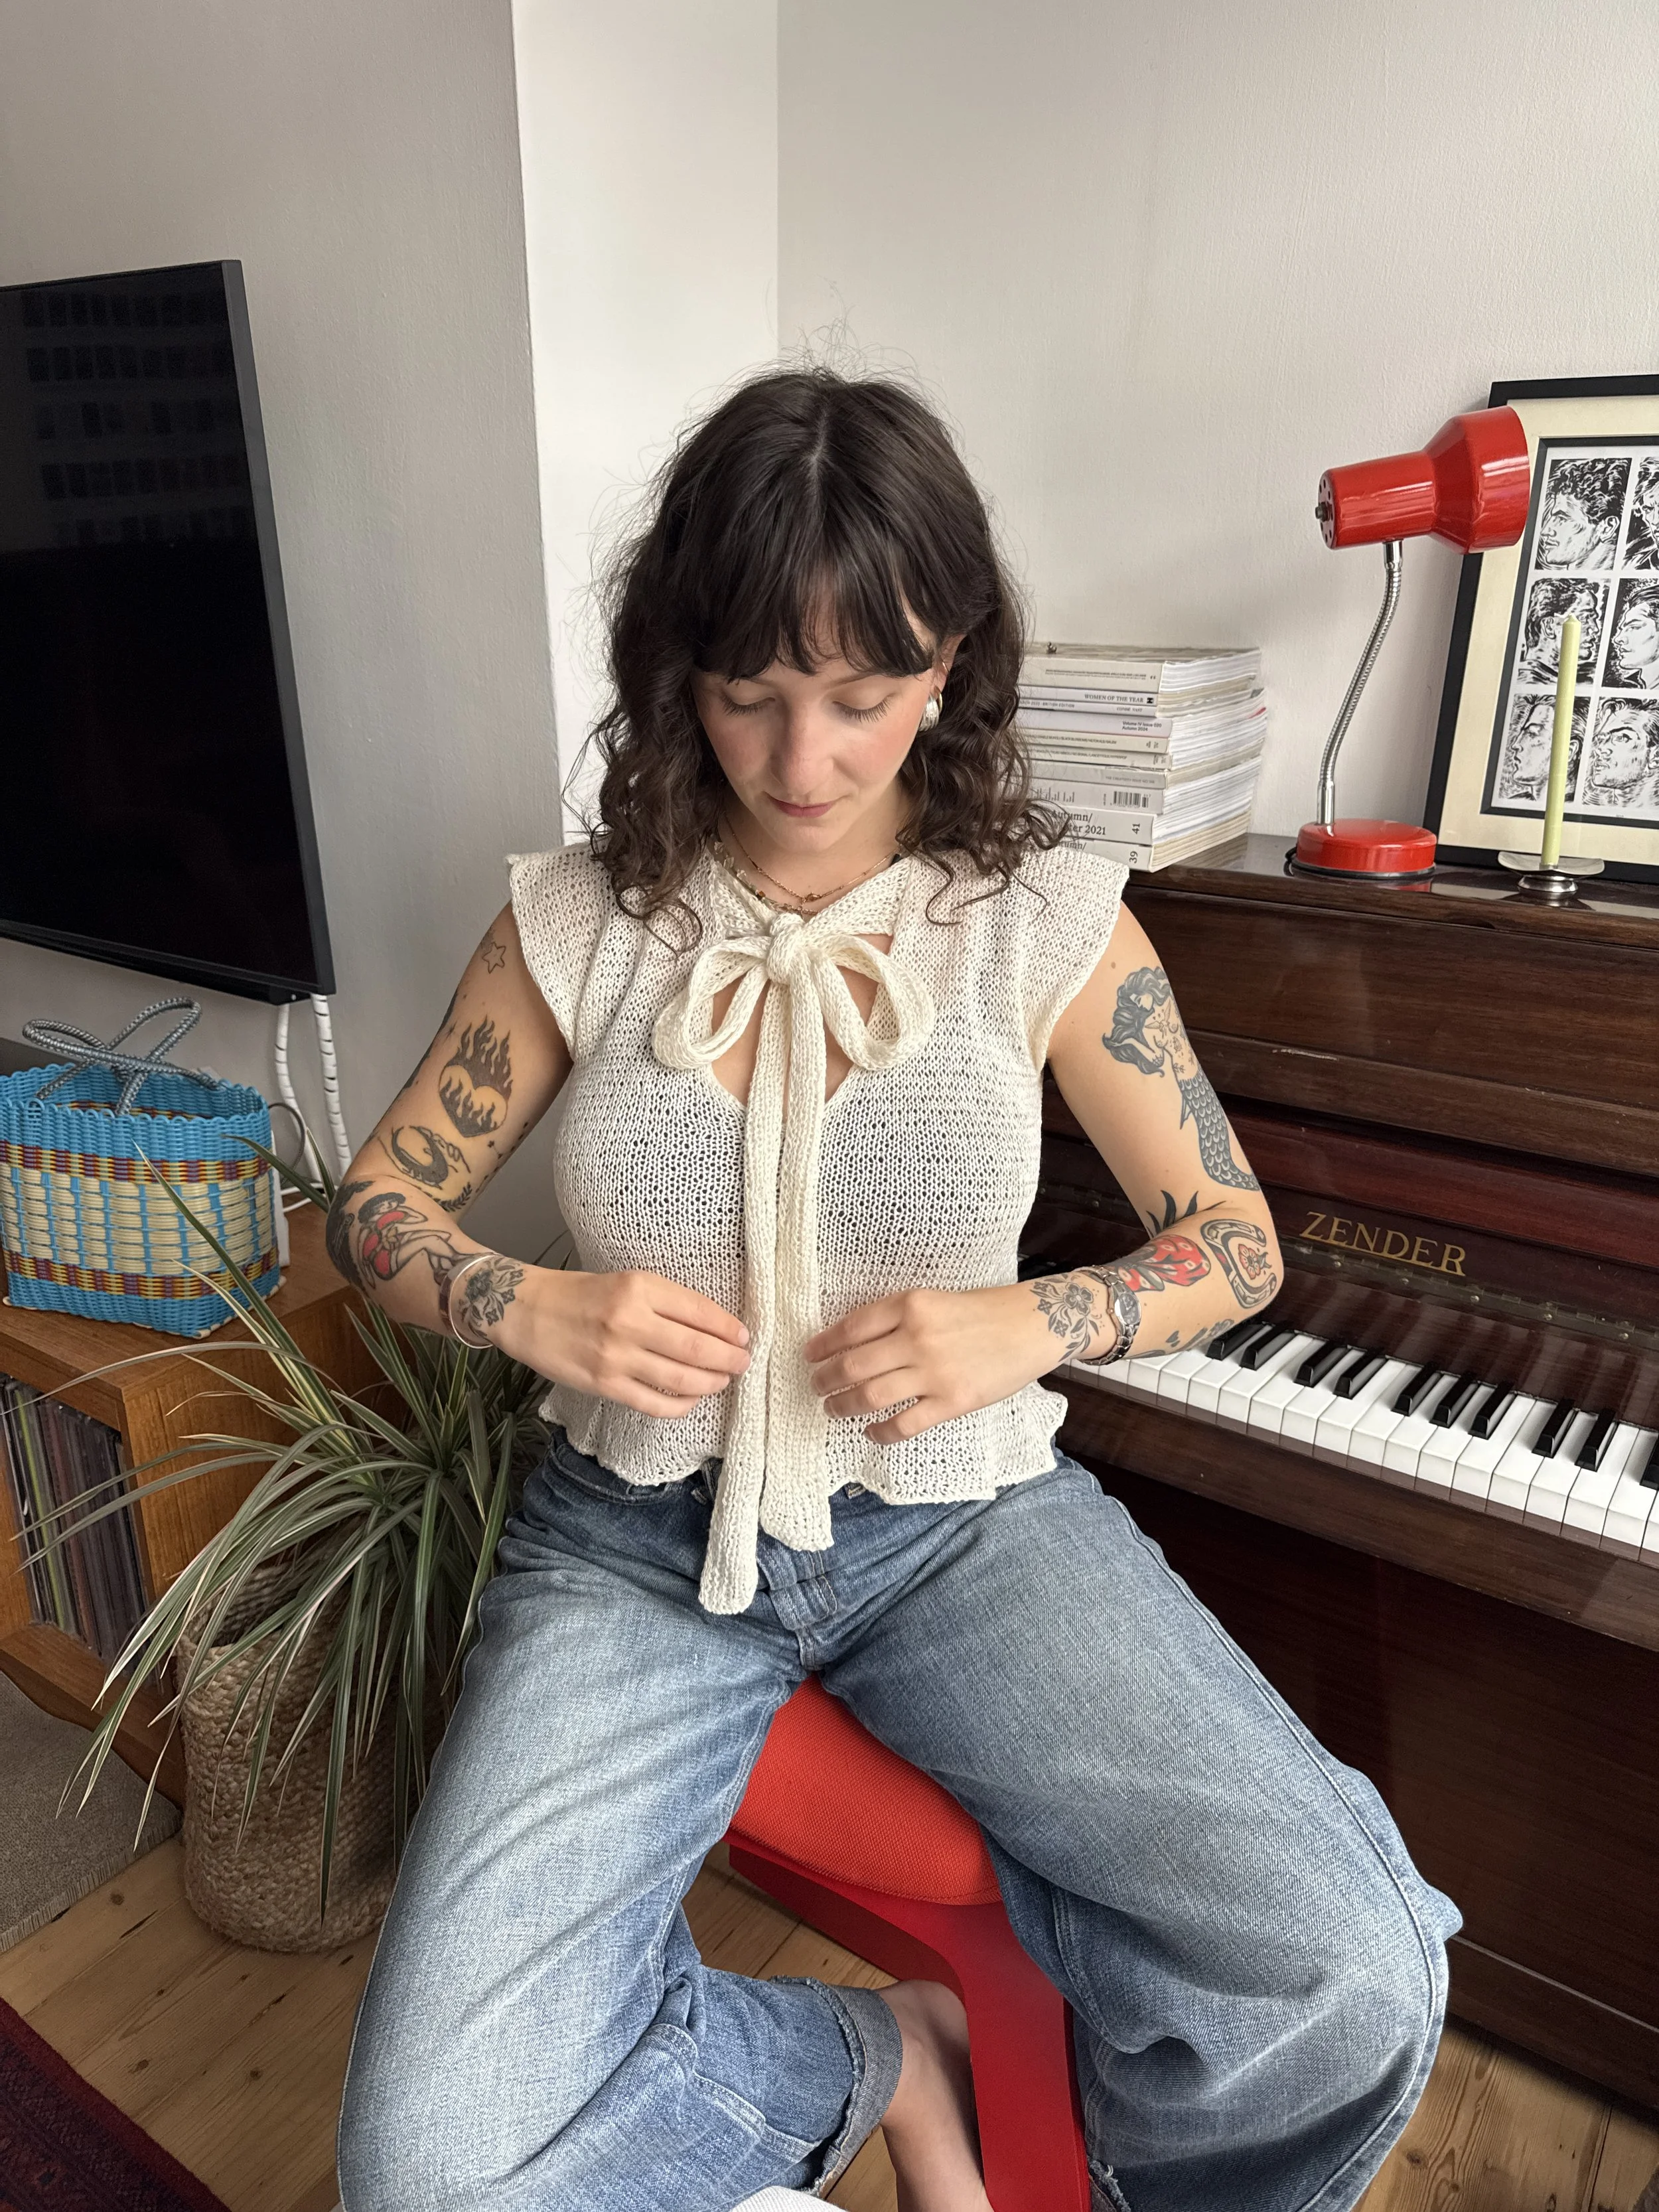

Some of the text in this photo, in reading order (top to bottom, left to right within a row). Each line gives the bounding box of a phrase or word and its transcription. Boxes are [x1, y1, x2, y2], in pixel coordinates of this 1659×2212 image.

[1085, 825, 1106, 836] 2021
[1131, 823, 1140, 834] 41
[1129, 851, 1138, 863] 39
[1299, 1211, 1466, 1276] ZENDER
